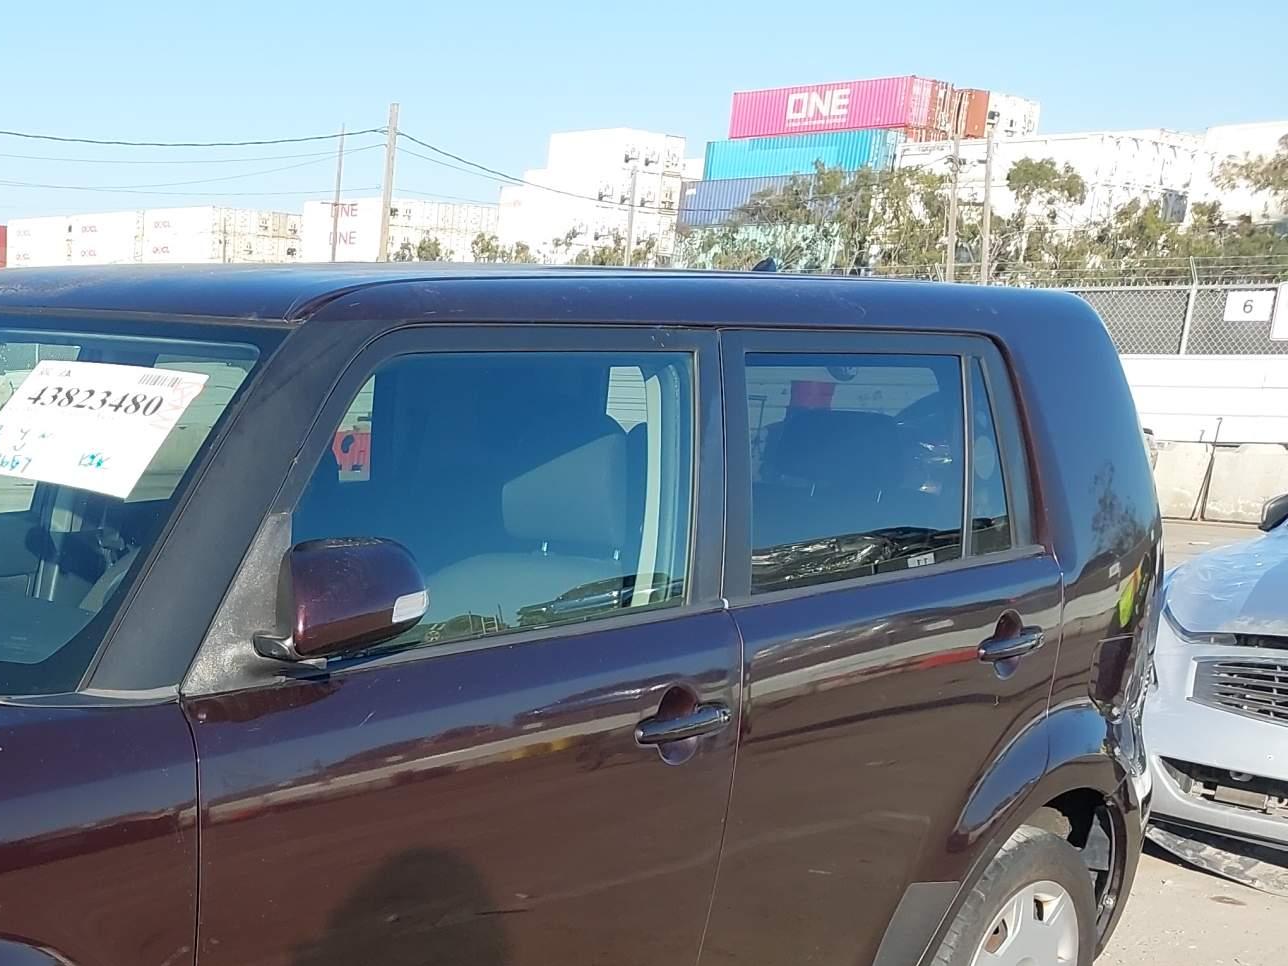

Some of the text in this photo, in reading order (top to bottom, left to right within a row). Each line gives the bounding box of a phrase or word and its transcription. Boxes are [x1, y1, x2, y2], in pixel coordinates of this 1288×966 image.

[786, 88, 850, 119] ONE
[1242, 299, 1253, 313] 6
[27, 386, 164, 417] 43823480
